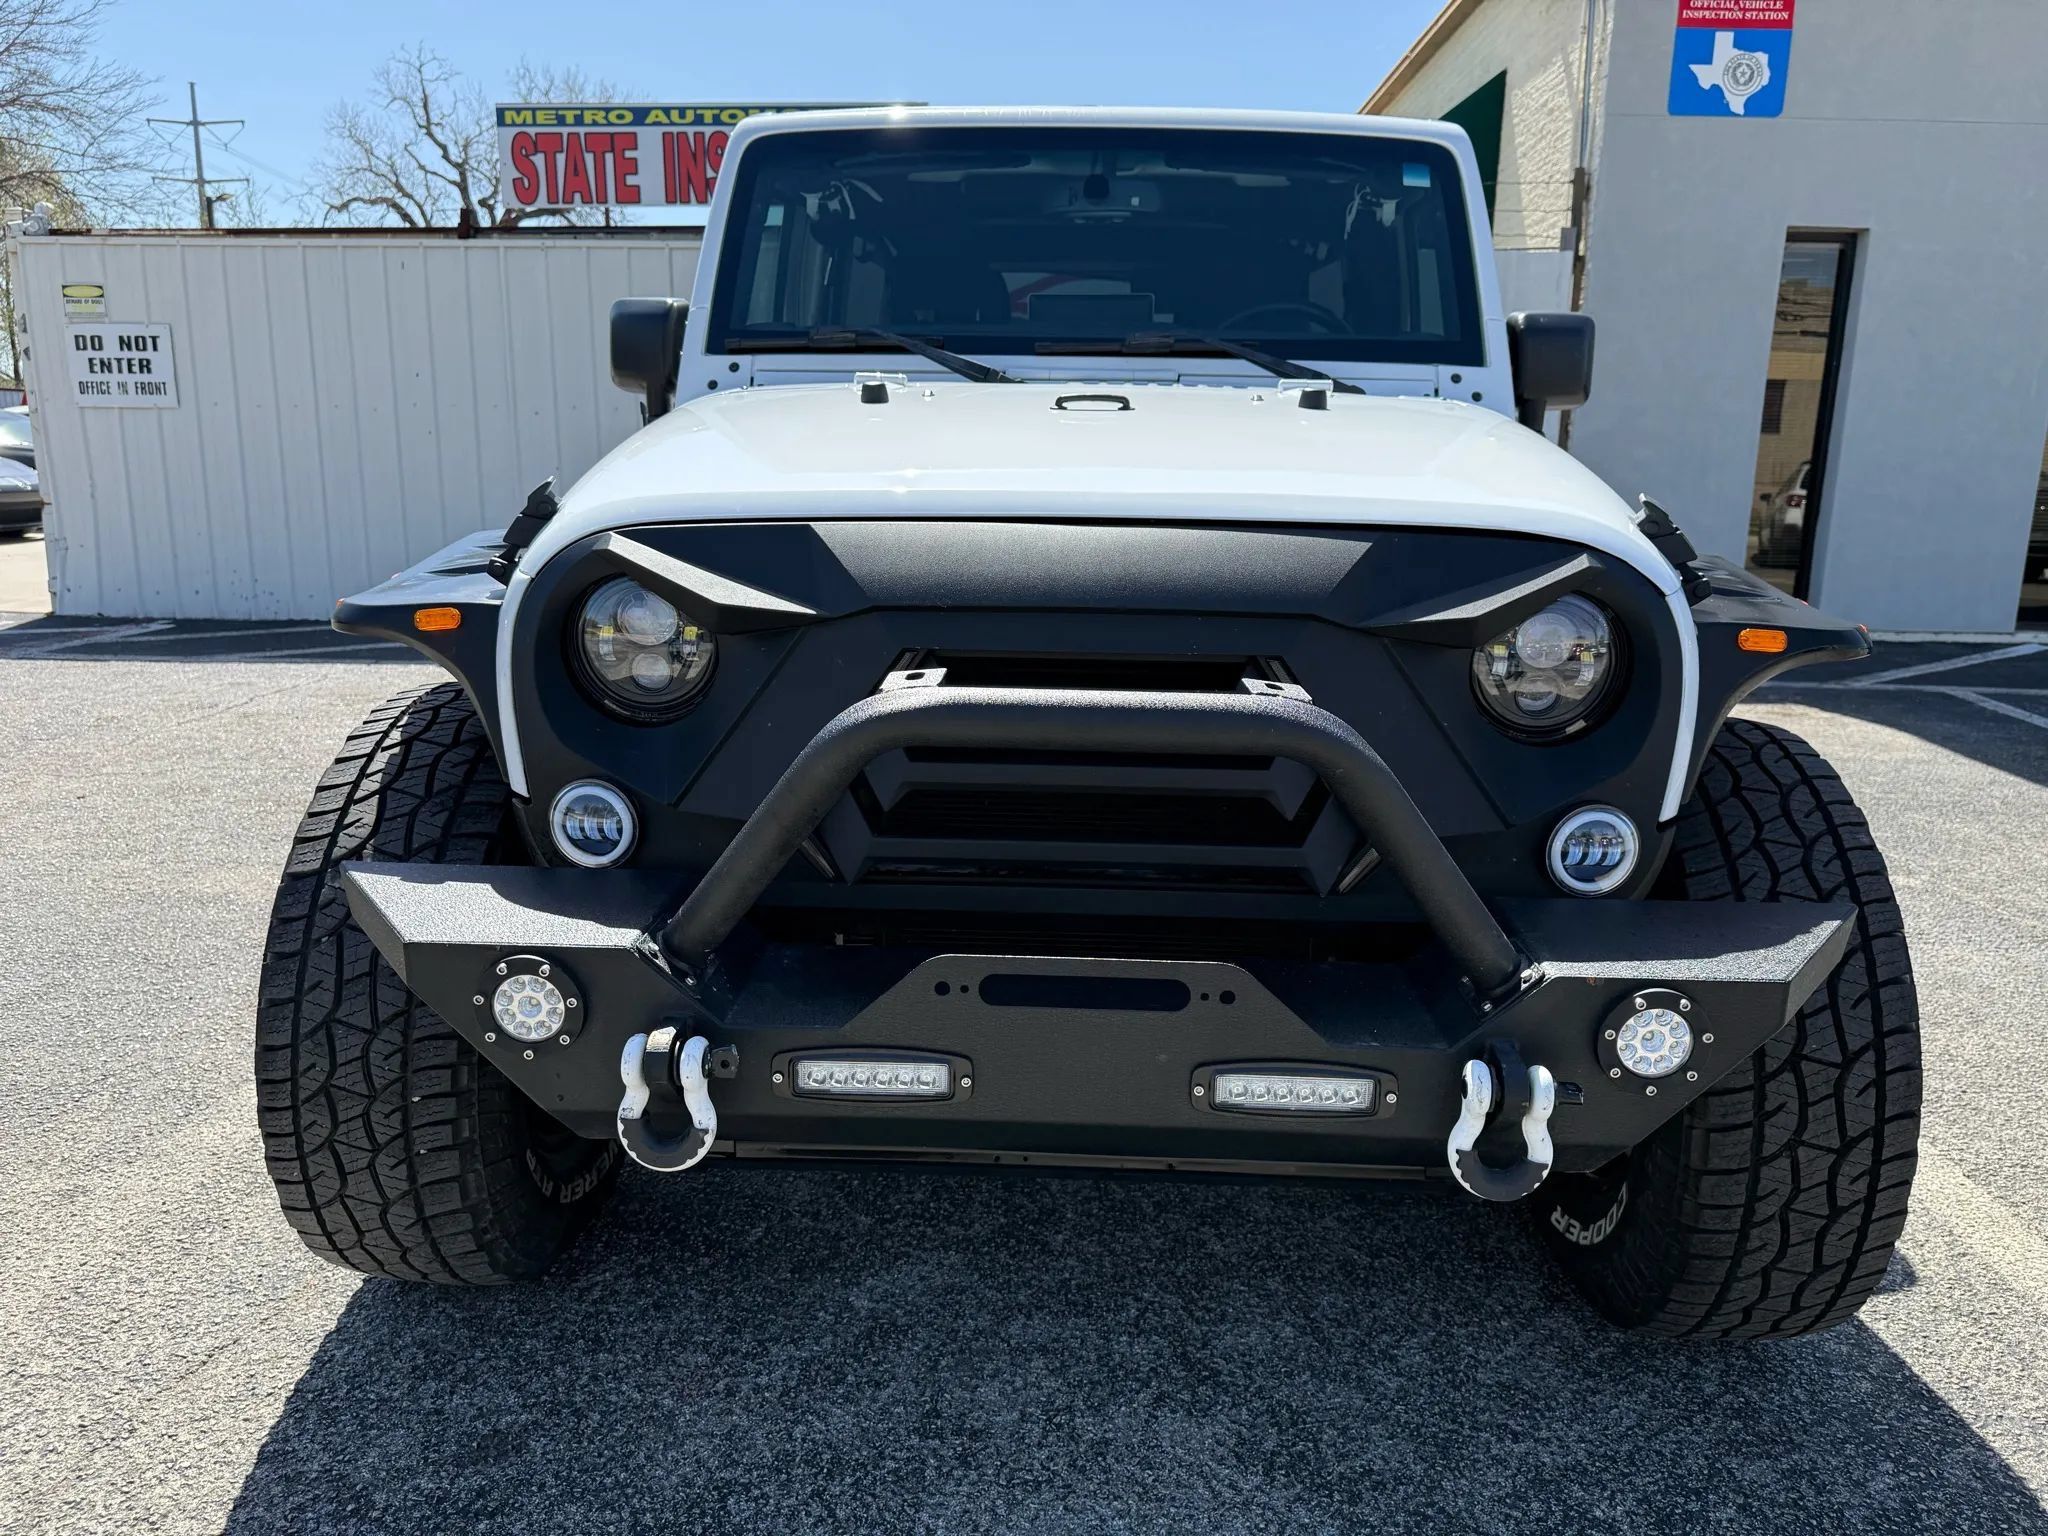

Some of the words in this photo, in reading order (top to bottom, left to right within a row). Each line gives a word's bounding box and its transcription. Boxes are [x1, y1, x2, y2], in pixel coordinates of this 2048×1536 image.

[1689, 0, 1735, 9] OFFICIAL
[1739, 0, 1784, 9] VEHICLE
[1682, 9, 1743, 20] INSPECTION
[1744, 11, 1789, 20] STATION
[504, 108, 634, 126] METRO
[644, 109, 760, 126] AUTO
[511, 131, 641, 206] STATE
[74, 335, 104, 351] DO
[118, 335, 160, 352] NOT
[88, 357, 152, 375] ENTER
[78, 380, 112, 396] OFFICE
[117, 381, 129, 396] IN
[134, 381, 167, 396] FRONT
[1550, 1180, 1628, 1246] COOPER
